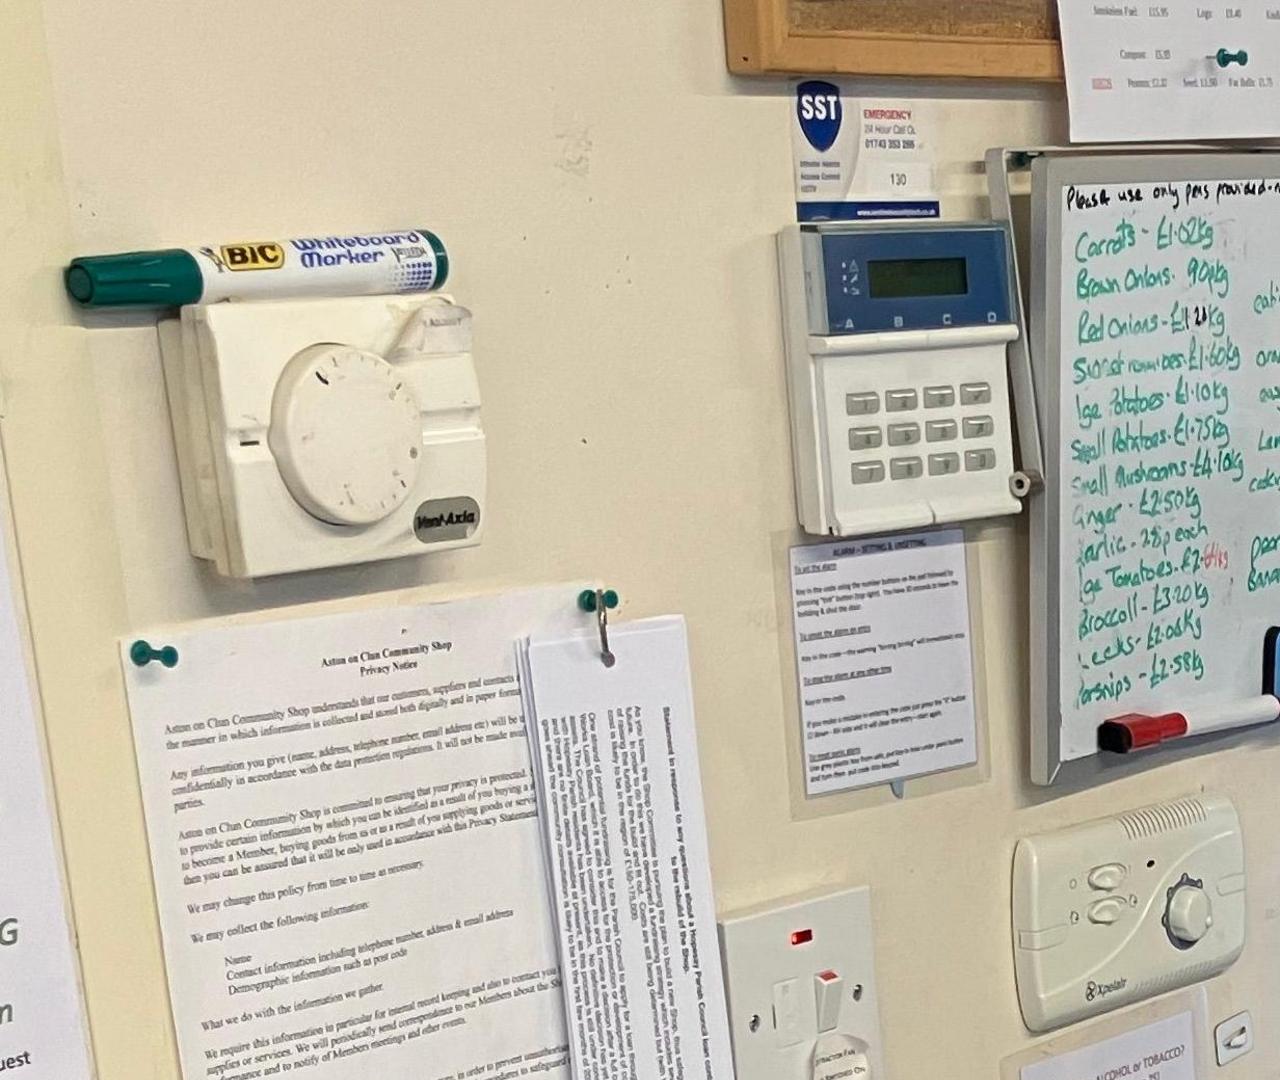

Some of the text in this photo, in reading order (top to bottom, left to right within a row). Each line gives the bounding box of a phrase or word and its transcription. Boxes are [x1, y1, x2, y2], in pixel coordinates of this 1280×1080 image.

[801, 95, 837, 120] SST
[864, 110, 911, 120] EMERGENCY
[1118, 188, 1143, 202] use
[1153, 184, 1179, 210] only
[1185, 185, 1209, 207] pens
[290, 231, 421, 252] Whiteboard
[227, 244, 280, 265] BIC
[300, 250, 386, 269] Marker
[321, 640, 452, 668] Aston on Clun Community Shop
[360, 659, 418, 677] Privacy Notice
[258, 890, 275, 900] this
[278, 885, 304, 900] policy
[307, 881, 327, 892] from
[224, 954, 251, 966] Name
[226, 956, 316, 980] Contact information
[697, 1002, 708, 1037] Council
[702, 1039, 712, 1058] loan
[1133, 1062, 1141, 1072] or
[1143, 1044, 1185, 1069] TOBACCO?
